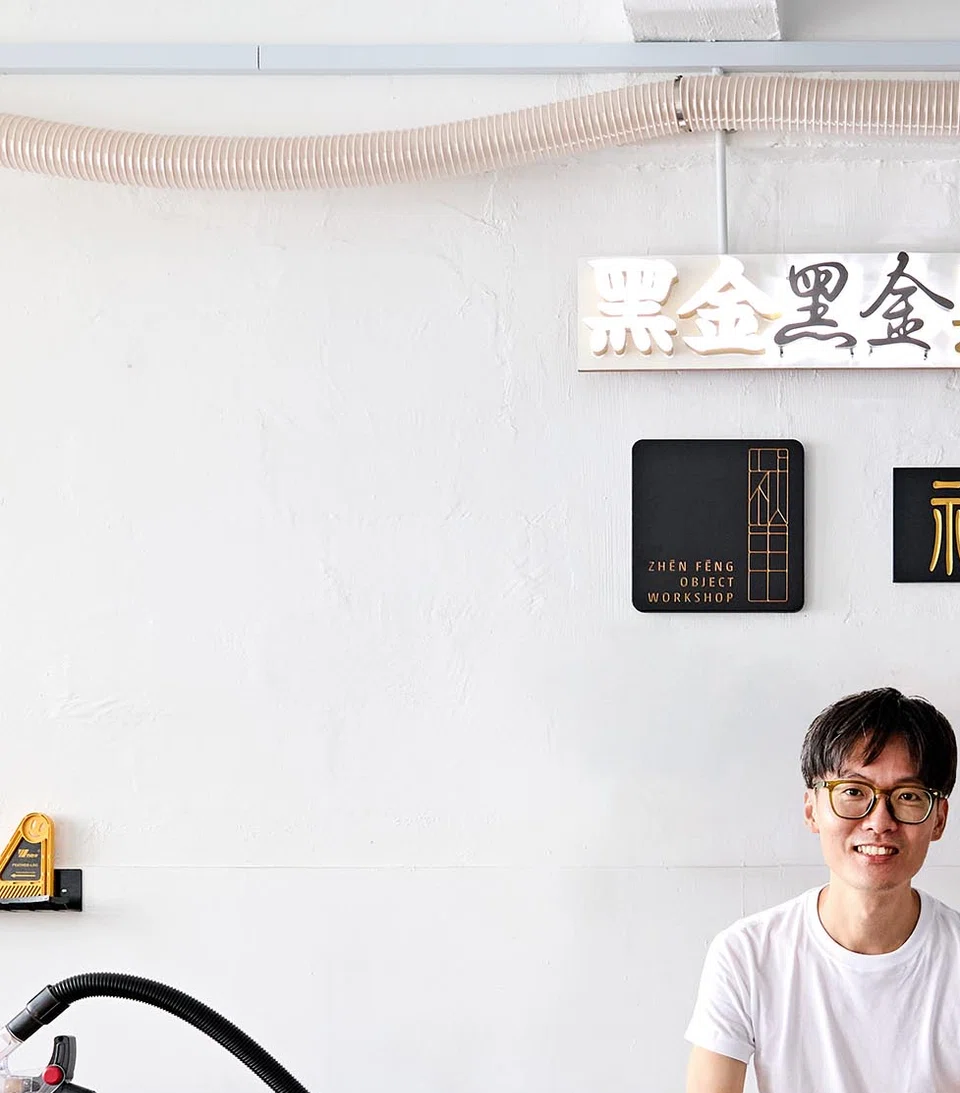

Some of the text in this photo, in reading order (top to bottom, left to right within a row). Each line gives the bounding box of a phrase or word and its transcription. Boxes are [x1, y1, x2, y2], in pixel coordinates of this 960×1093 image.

[648, 559, 734, 572] ZHĒN FĒNG
[680, 577, 734, 588] OBJECT
[647, 592, 734, 604] WORKSHOP
